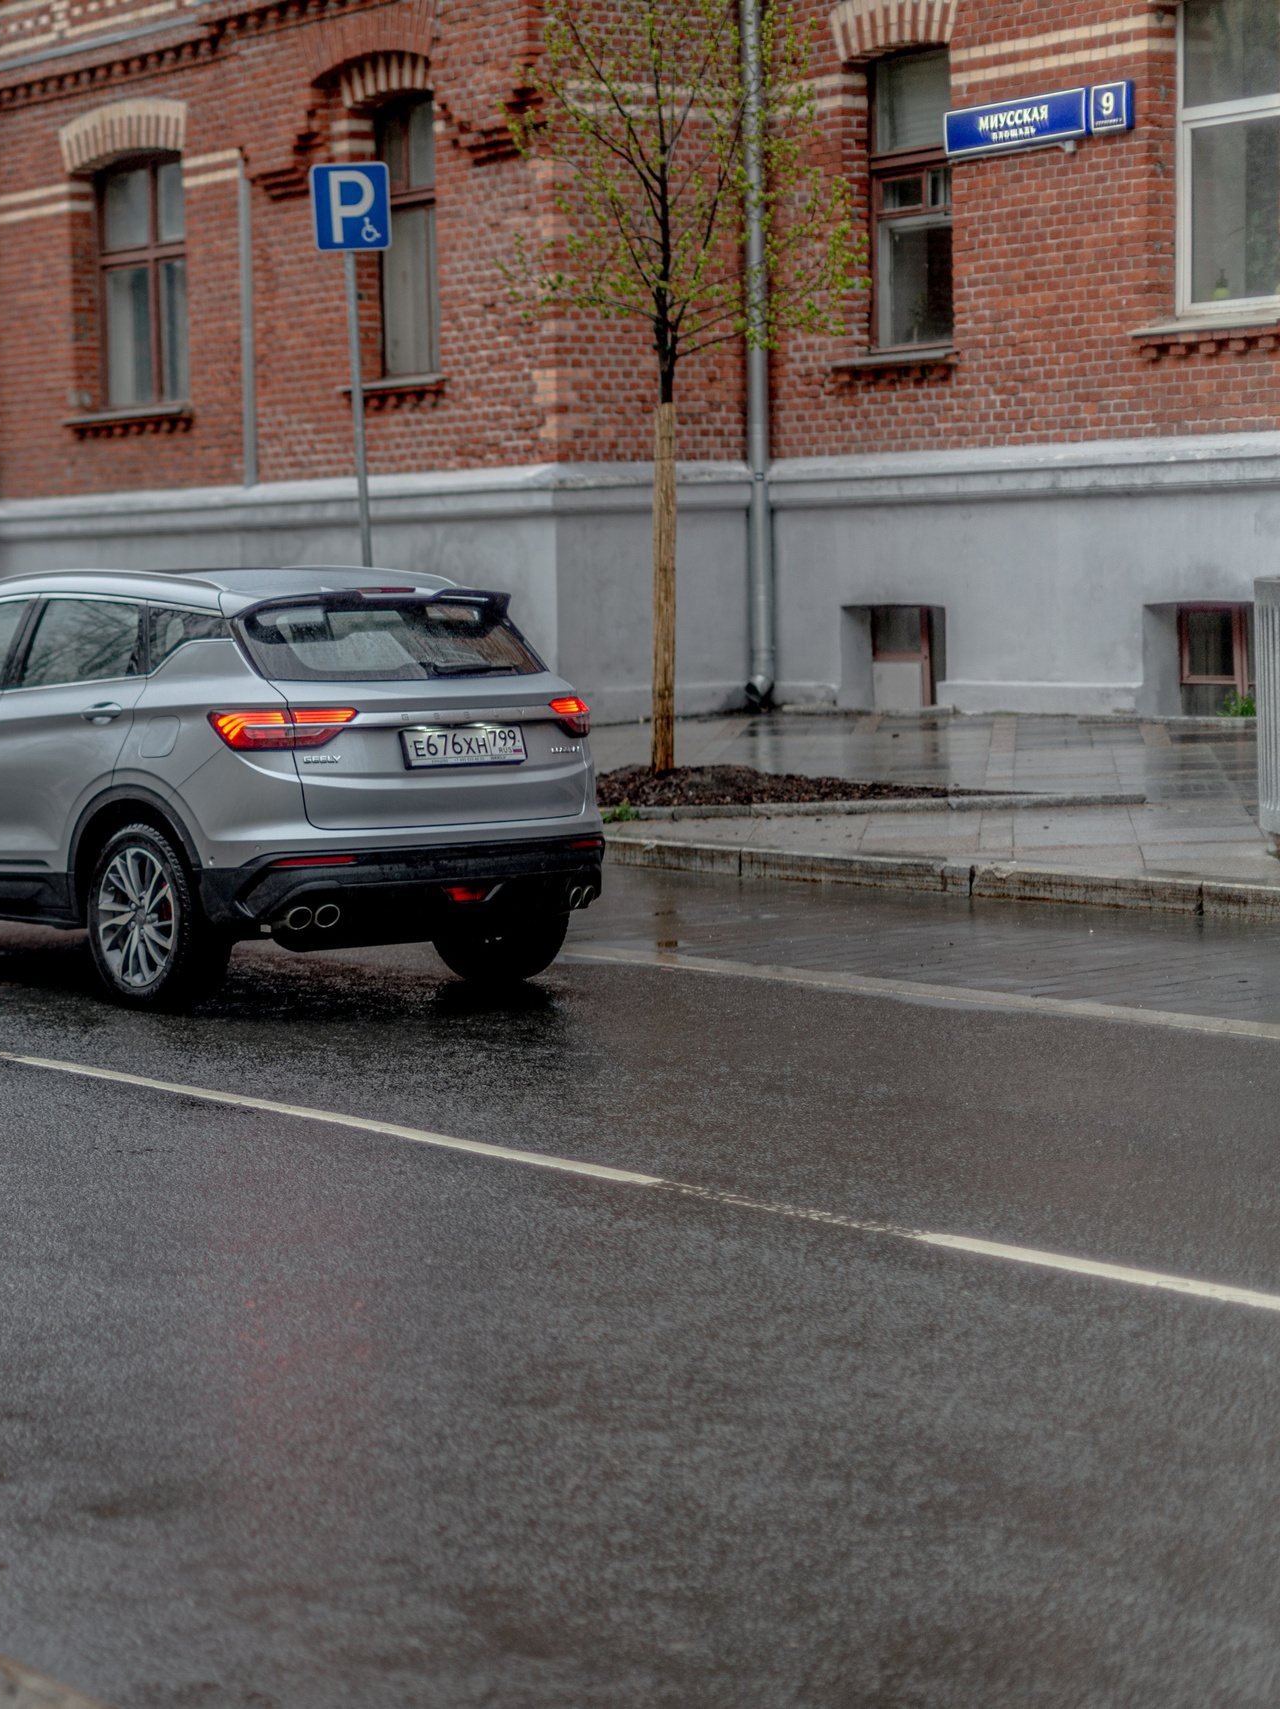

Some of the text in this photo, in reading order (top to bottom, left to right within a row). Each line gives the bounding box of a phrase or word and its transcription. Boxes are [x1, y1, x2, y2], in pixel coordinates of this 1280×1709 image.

[1102, 91, 1115, 115] 9
[978, 105, 1049, 131] МИУССКАЯ
[991, 126, 1036, 142] ПЛОЩАДЬ
[328, 170, 375, 243] P
[401, 708, 525, 722] GEELY
[413, 729, 516, 758] E676XH 799
[498, 746, 513, 754] RUS
[302, 755, 342, 764] GEELY
